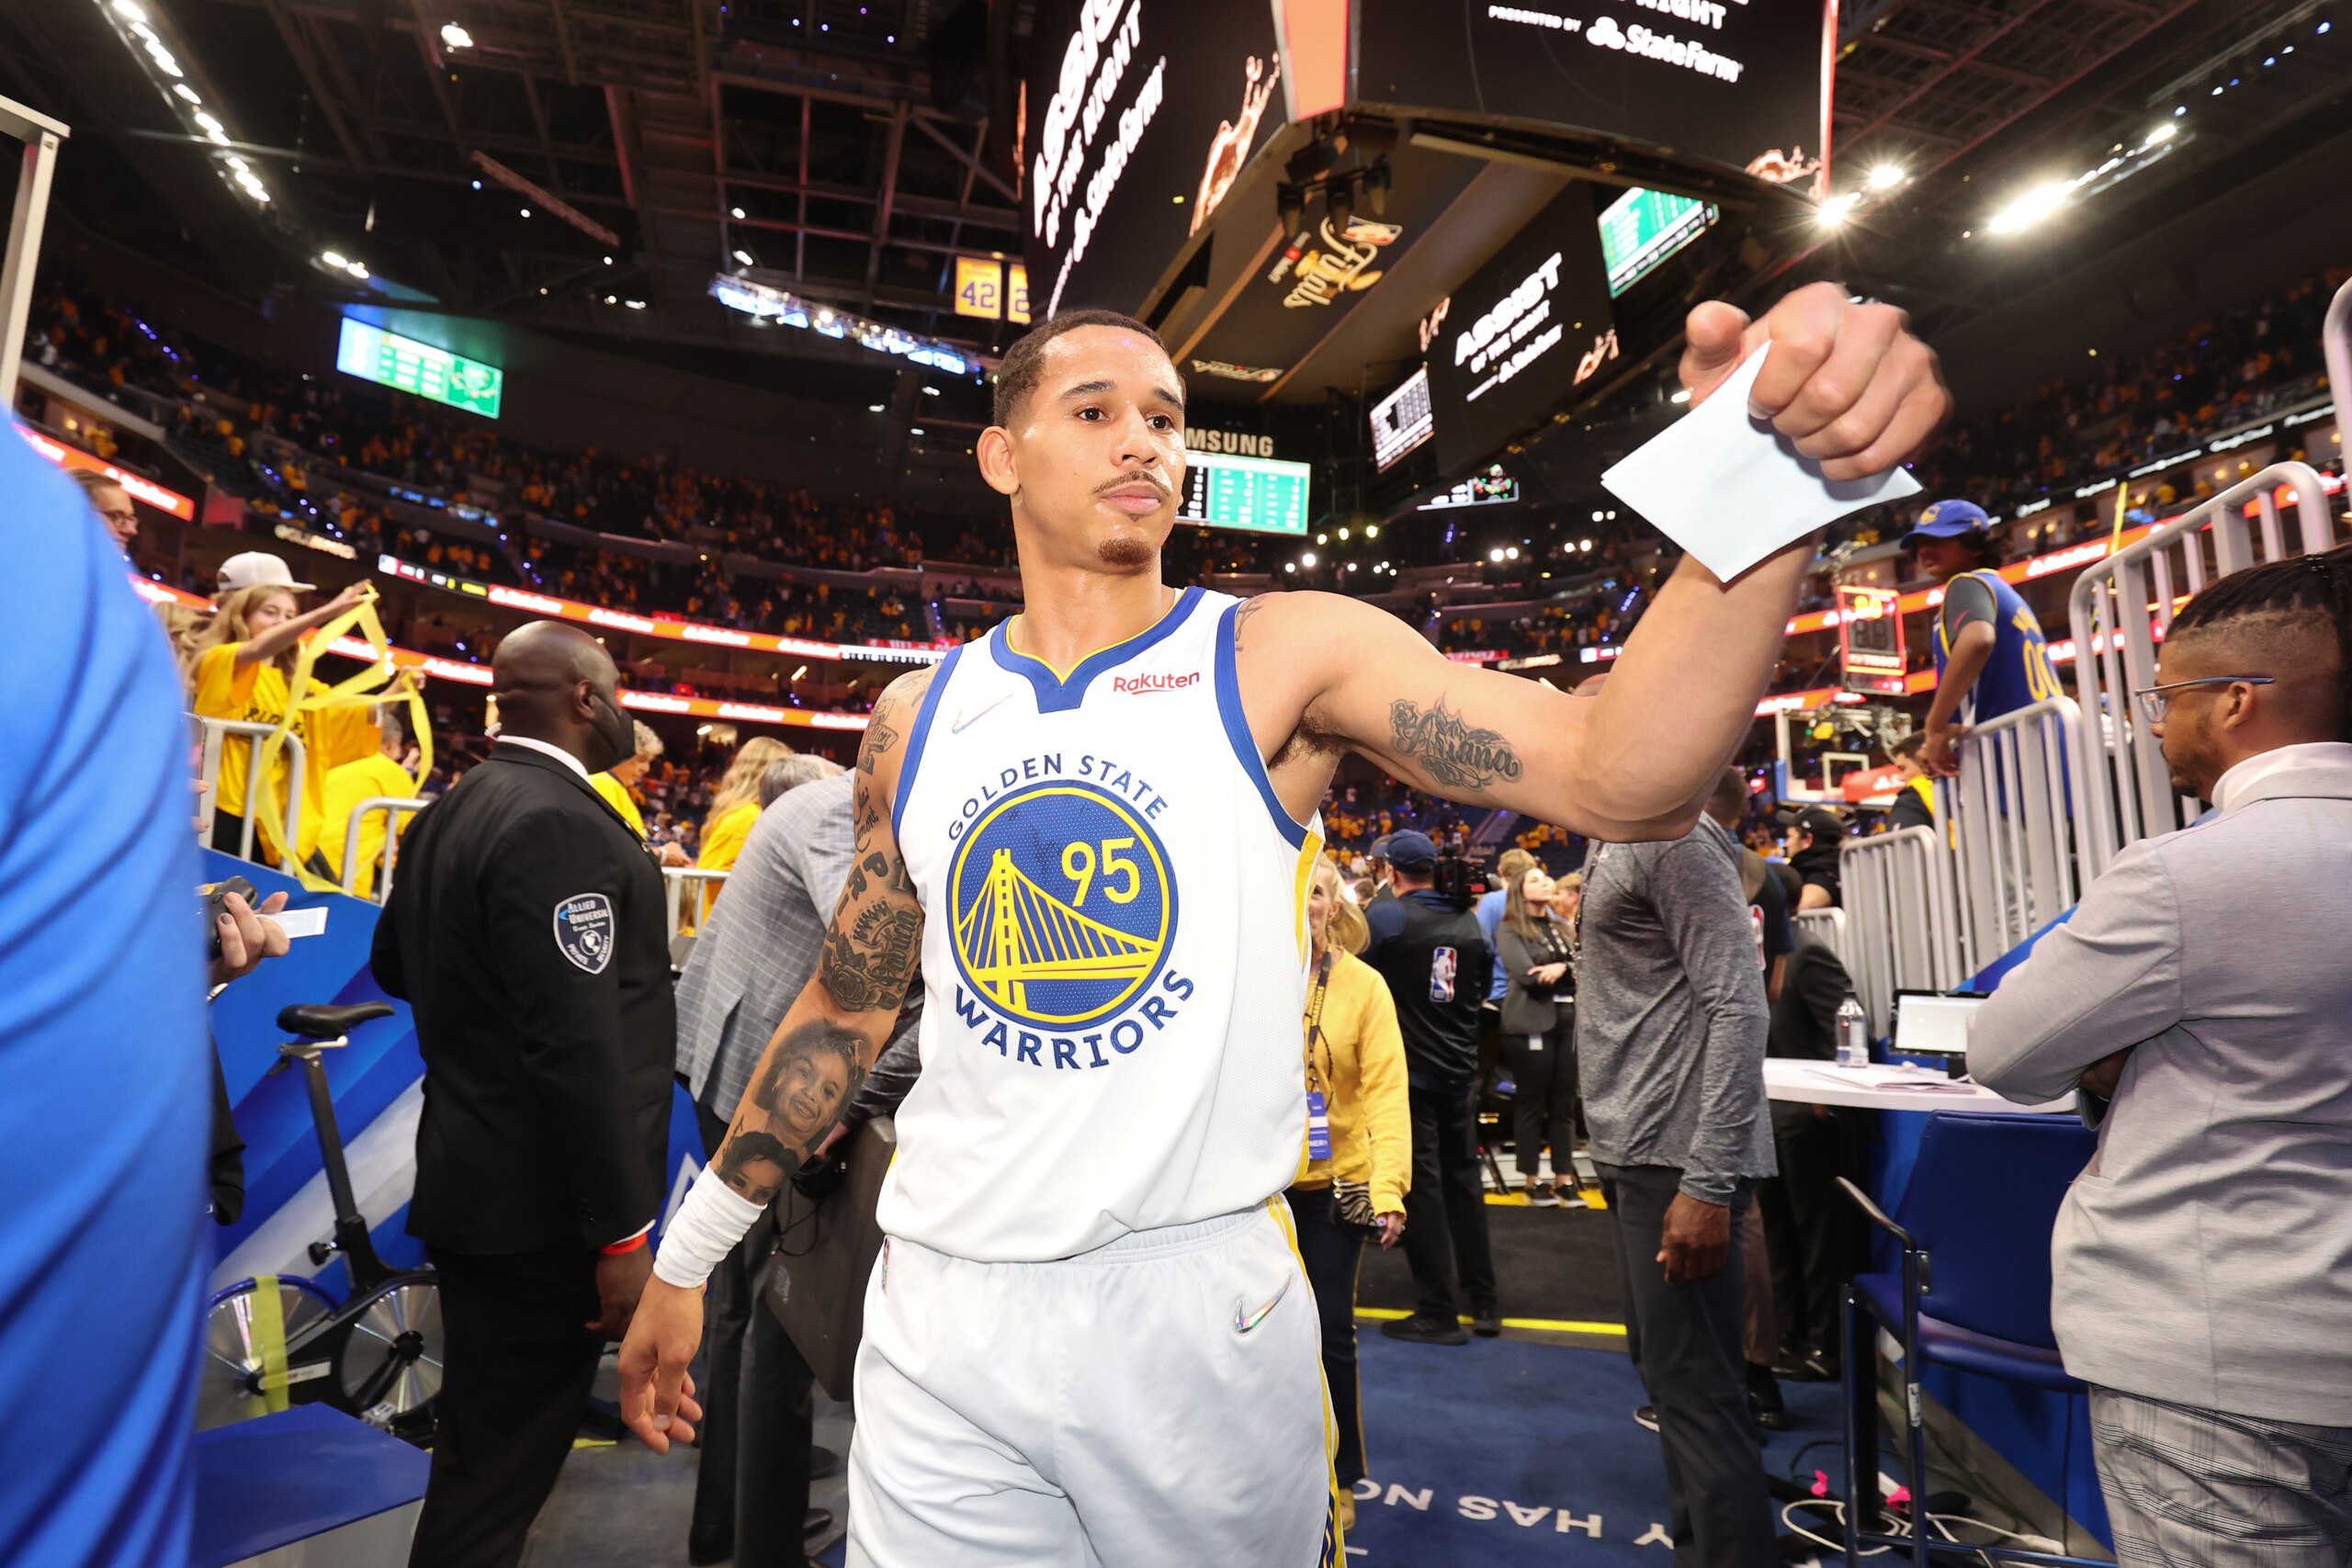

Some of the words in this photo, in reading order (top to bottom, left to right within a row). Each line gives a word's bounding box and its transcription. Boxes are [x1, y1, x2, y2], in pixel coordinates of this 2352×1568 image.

[1488, 5, 1563, 28] PRESENTED
[1564, 17, 1582, 31] BY
[961, 281, 995, 309] 42
[1185, 427, 1274, 457] MSUNG
[1113, 671, 1200, 695] Rakuten
[948, 753, 1062, 841] GOLDEN
[1078, 754, 1169, 820] STATE
[1061, 837, 1141, 908] 95
[567, 900, 596, 914] ALLIED
[956, 969, 1194, 1070] WARRIORS
[1457, 1495, 1602, 1539] HAS
